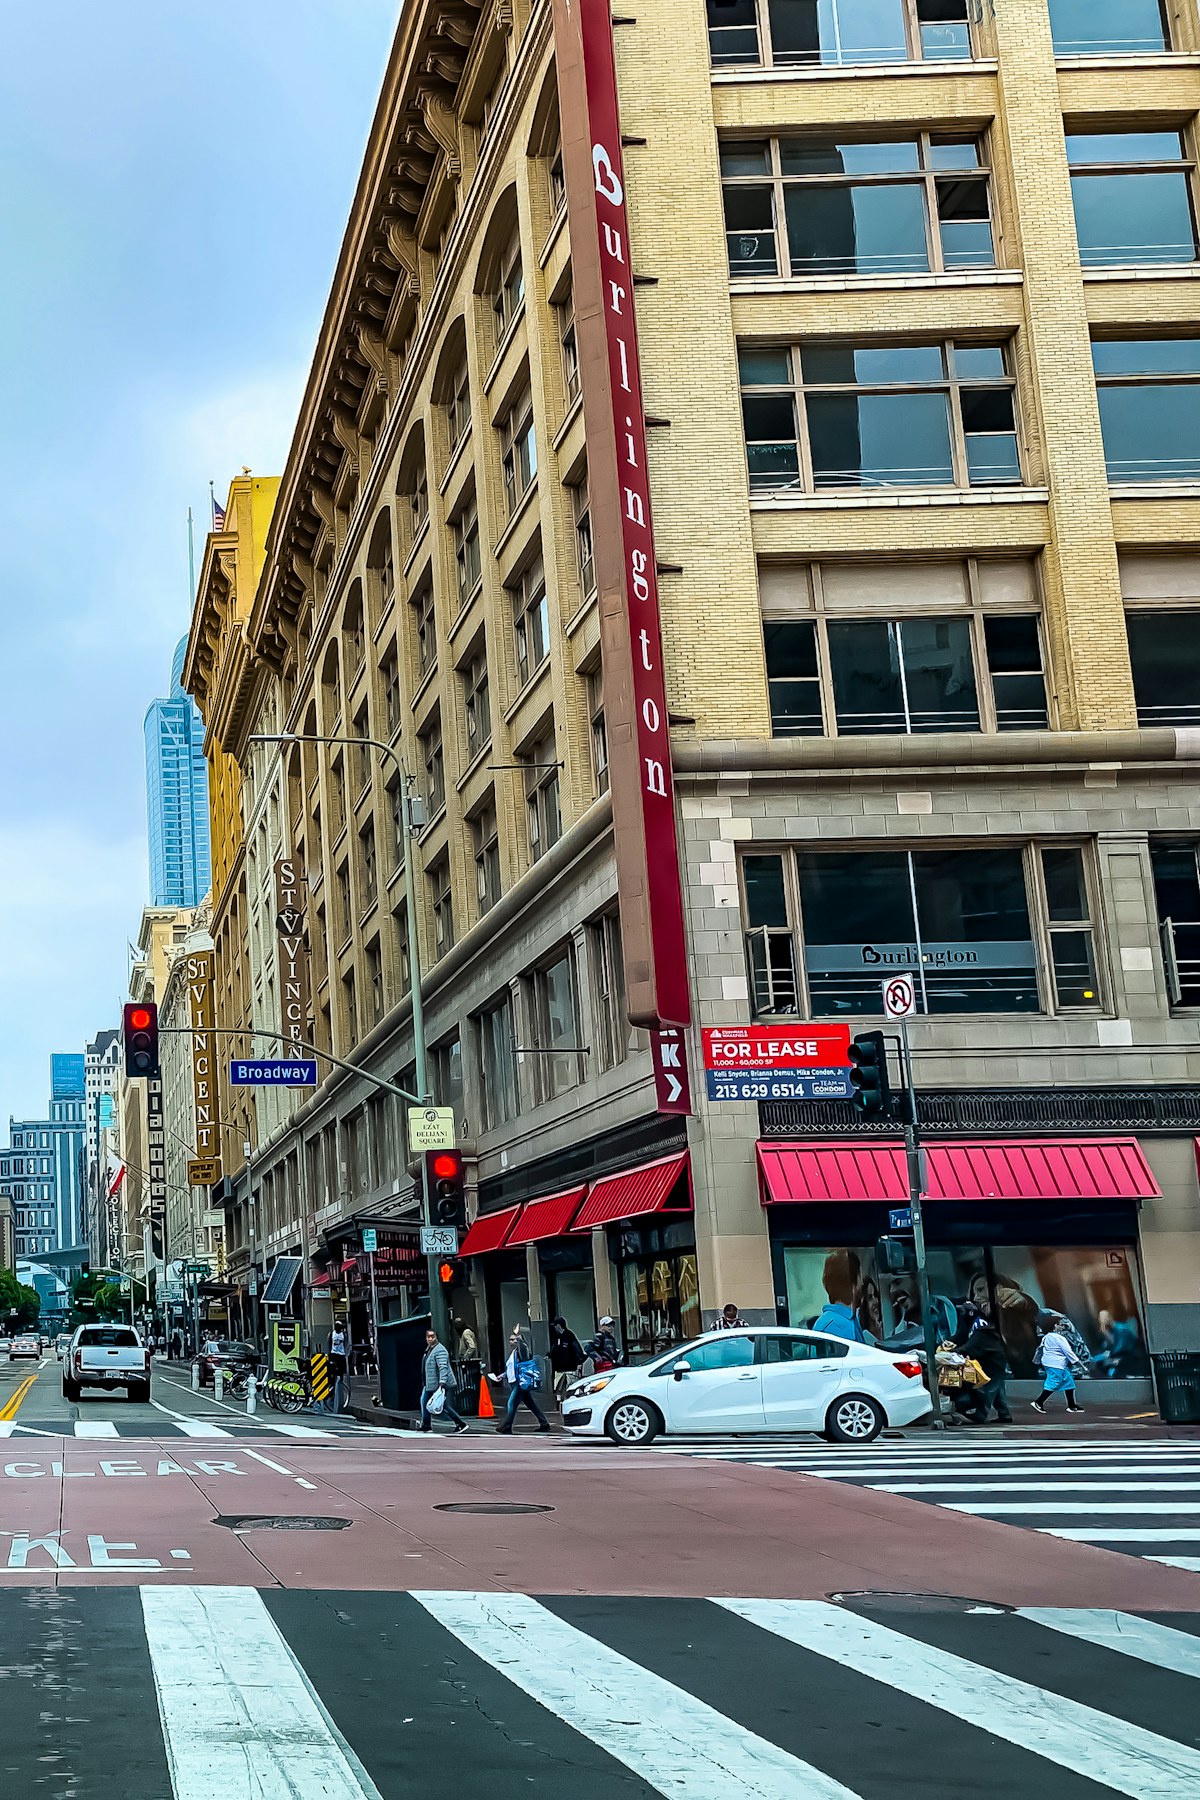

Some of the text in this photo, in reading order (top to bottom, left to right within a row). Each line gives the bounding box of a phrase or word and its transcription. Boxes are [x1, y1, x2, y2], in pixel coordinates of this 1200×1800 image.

[592, 143, 668, 798] Burlington
[280, 937, 305, 1060] VINCEN
[711, 1041, 818, 1058] FOR LEASE
[191, 983, 211, 1147] VINCENT
[238, 1066, 310, 1081] Broadway
[715, 1083, 804, 1099] 213 629 6514
[3, 1460, 248, 1478] CLEAR
